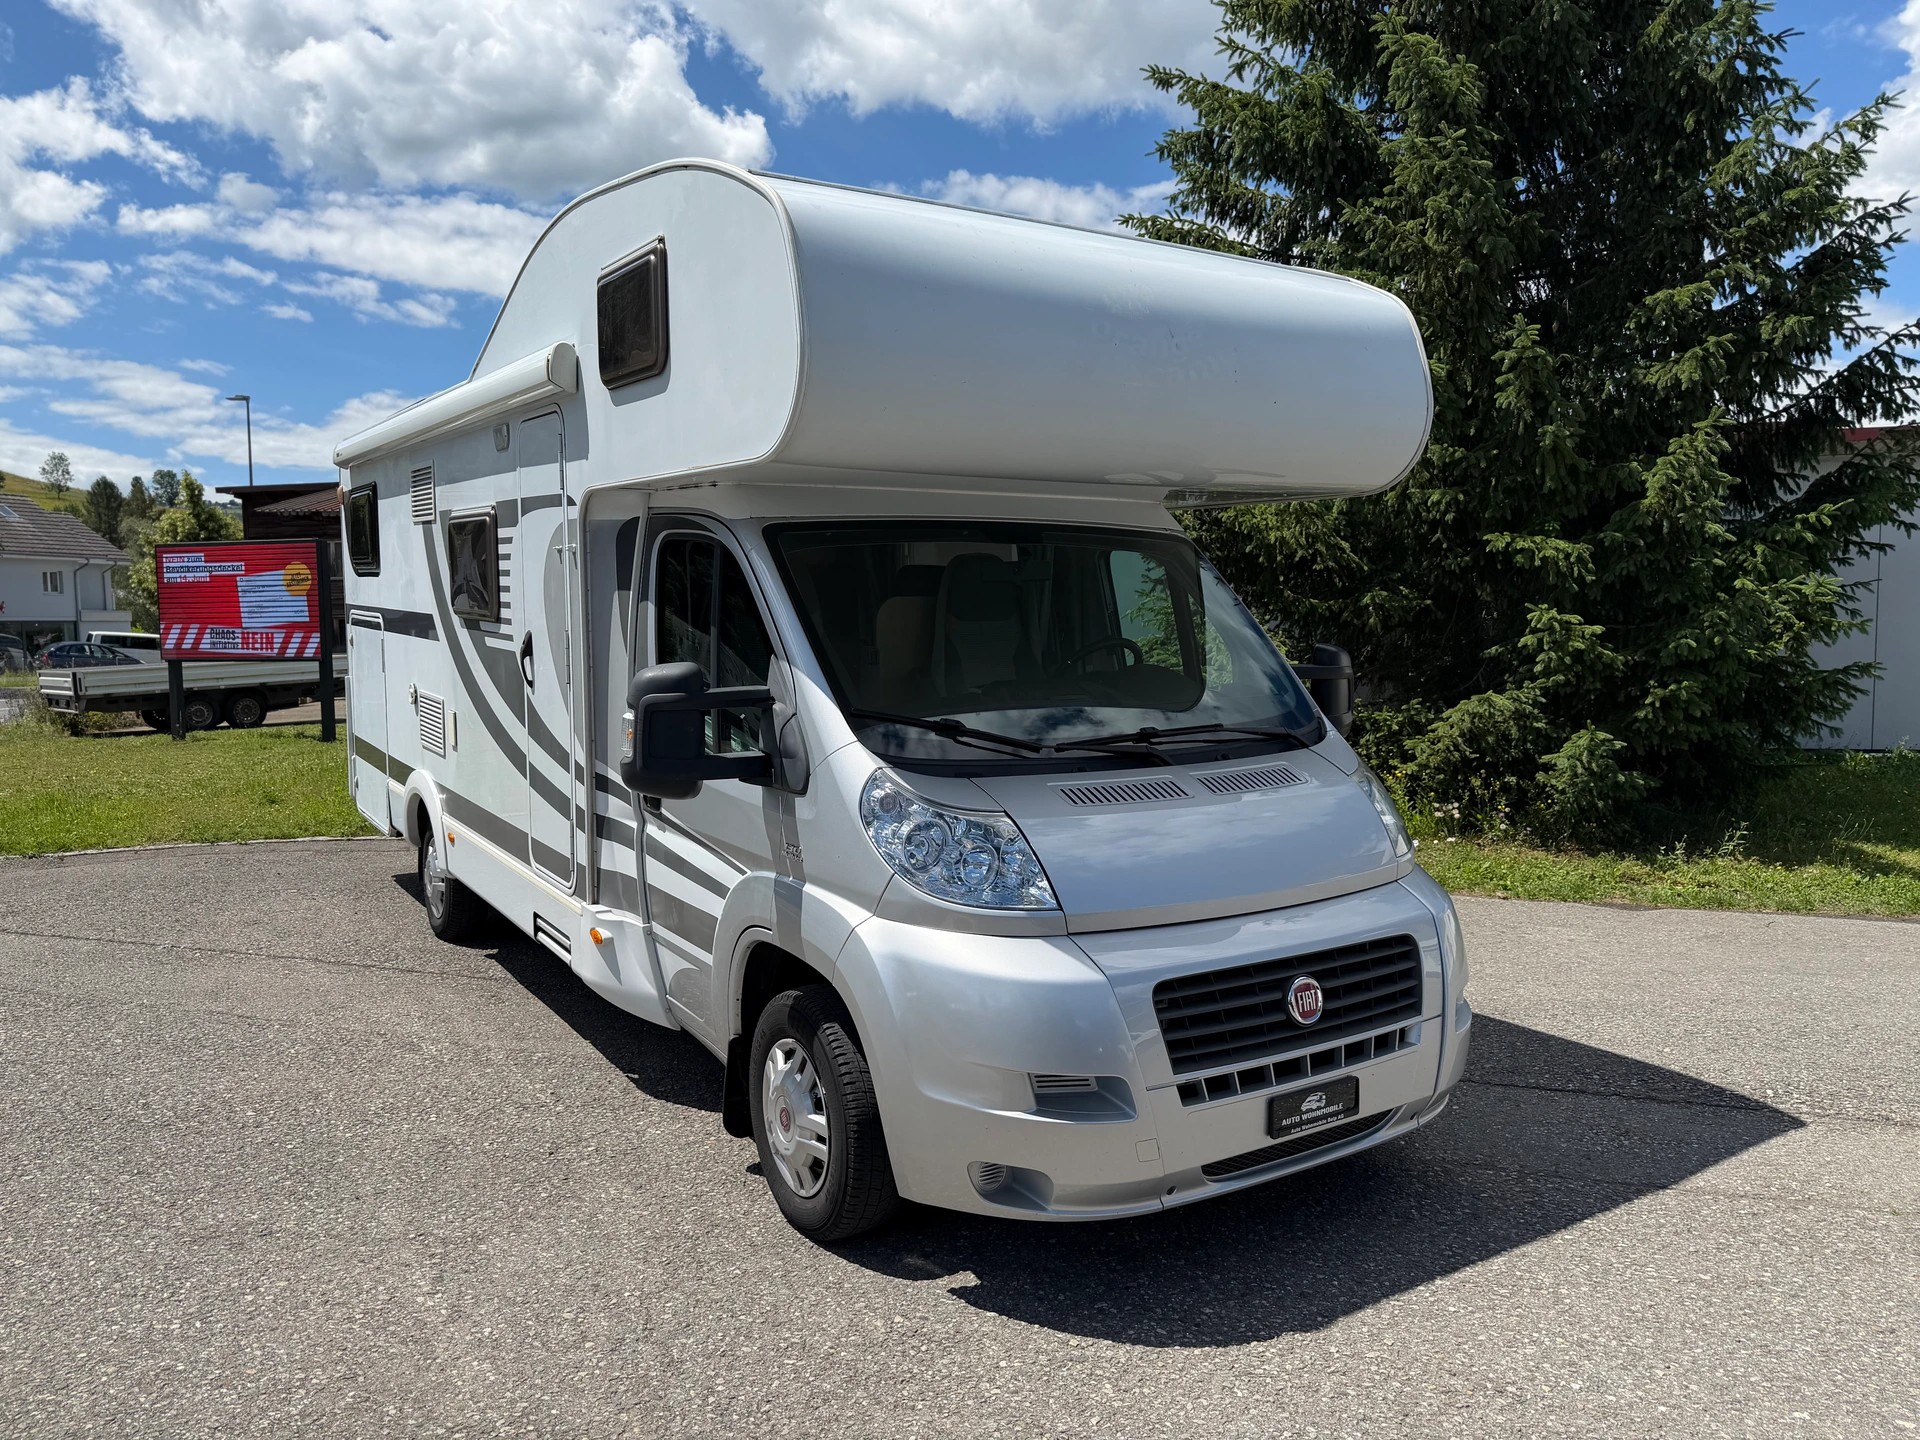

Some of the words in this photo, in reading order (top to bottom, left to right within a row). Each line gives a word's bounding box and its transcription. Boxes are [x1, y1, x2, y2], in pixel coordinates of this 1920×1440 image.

[210, 628, 240, 641] CHAOS-
[240, 631, 275, 652] NEIN
[1296, 989, 1316, 1013] FIAT
[1281, 1115, 1301, 1126] AUTO
[1301, 1102, 1344, 1121] WOHNMOBILE
[1290, 1126, 1301, 1134] Auto
